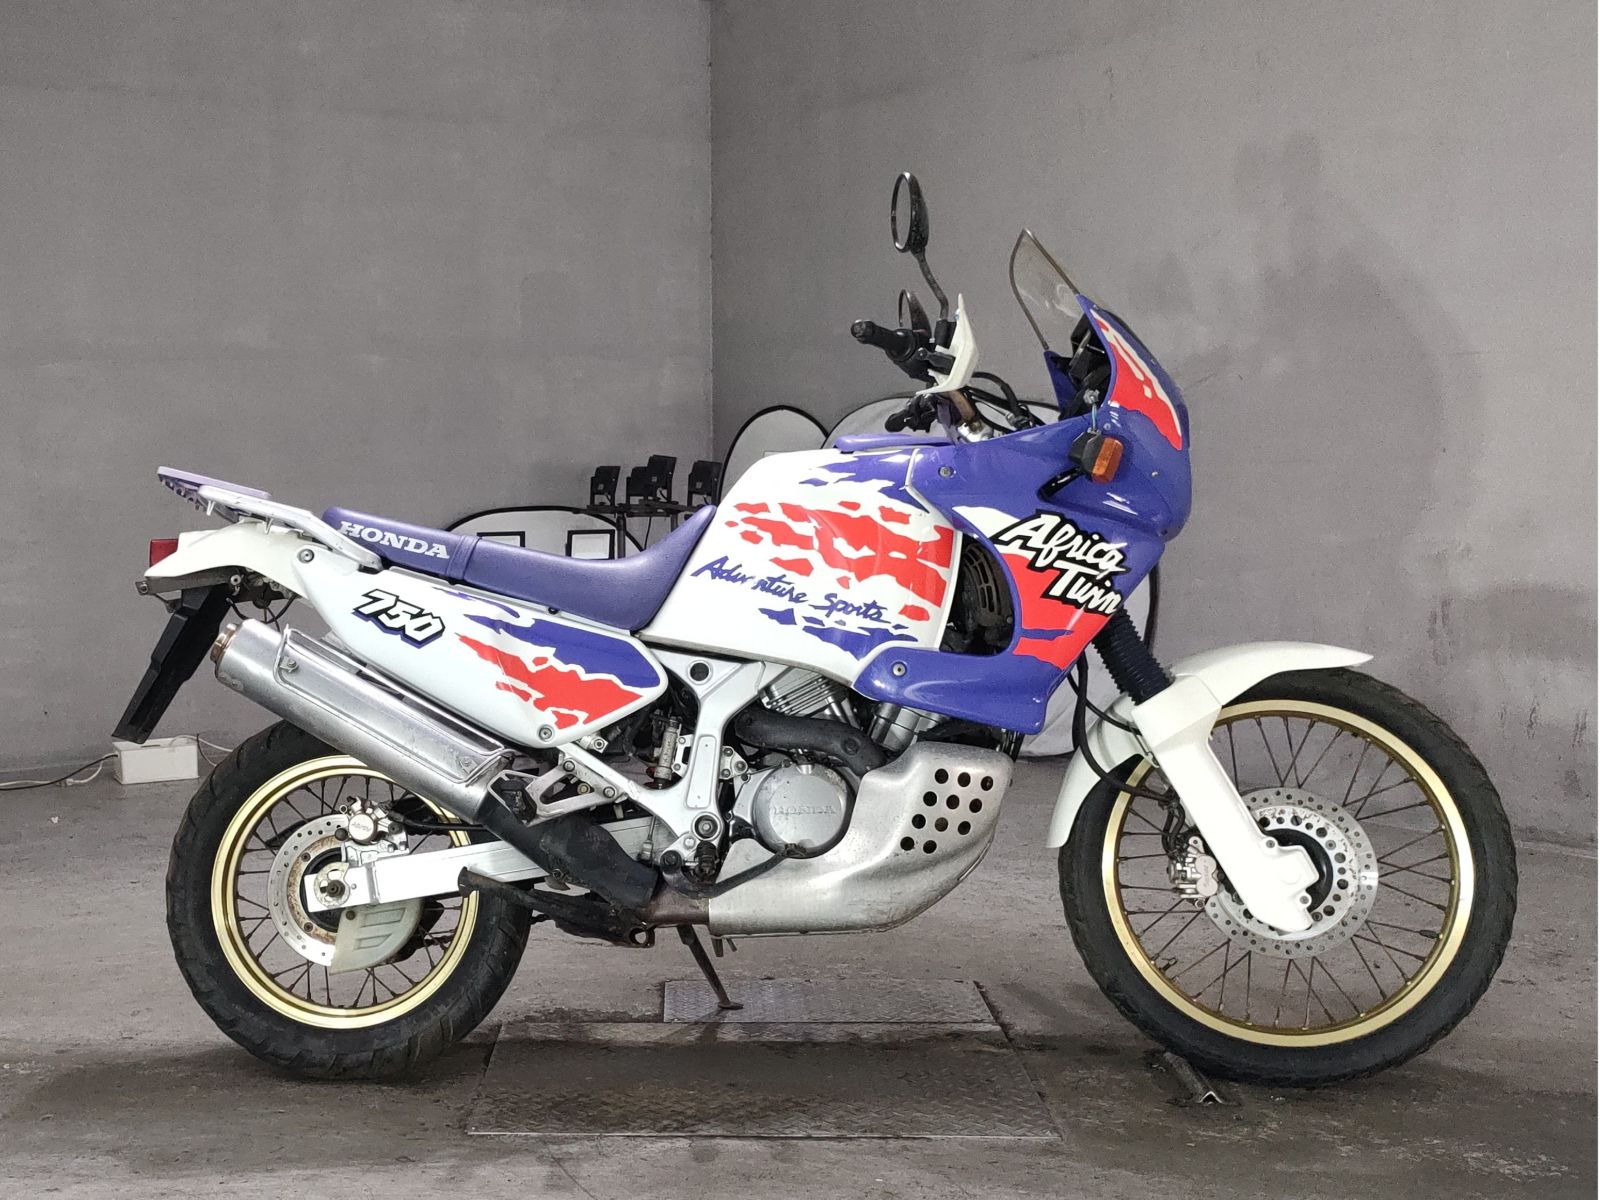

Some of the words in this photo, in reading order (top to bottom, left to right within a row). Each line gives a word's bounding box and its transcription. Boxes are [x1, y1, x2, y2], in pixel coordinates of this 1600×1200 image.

[341, 521, 450, 559] HONDA
[995, 511, 1130, 579] Africa
[690, 556, 809, 604] Advnture
[808, 593, 892, 624] Sports
[1046, 559, 1124, 616] Twin
[352, 588, 446, 648] 750
